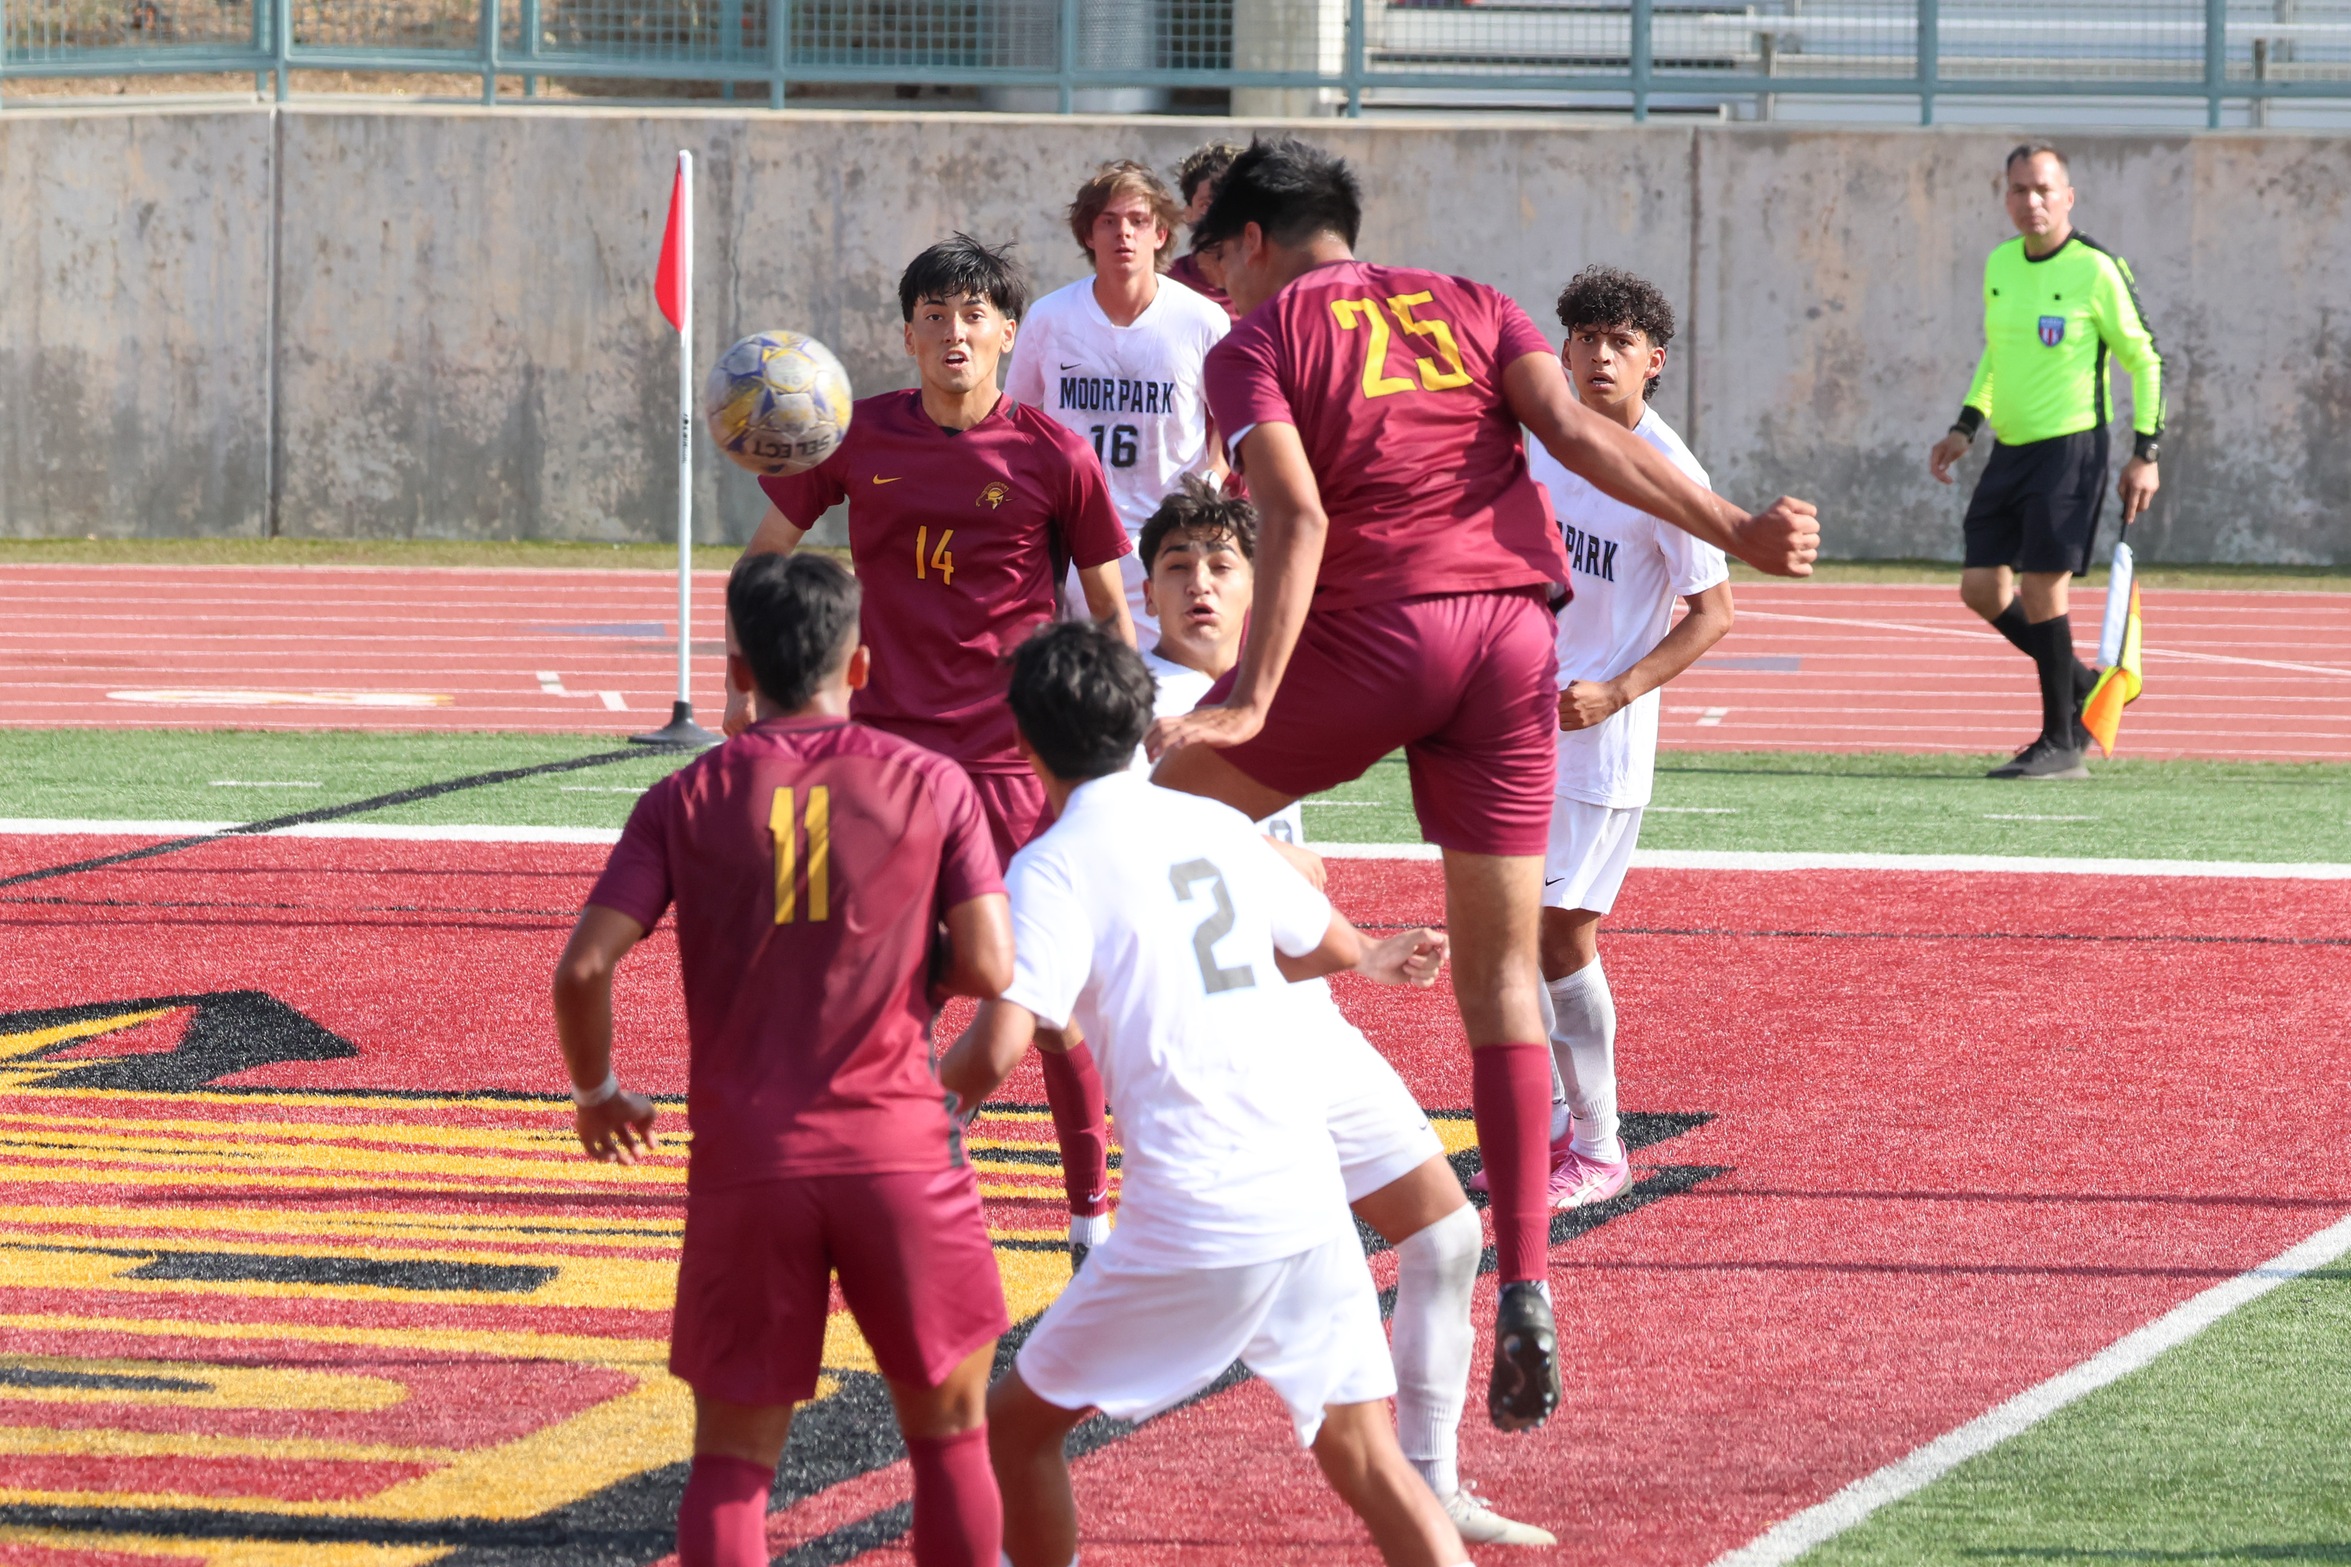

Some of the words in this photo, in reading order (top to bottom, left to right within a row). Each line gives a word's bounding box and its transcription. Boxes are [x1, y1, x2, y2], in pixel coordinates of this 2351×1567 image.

[1329, 288, 1475, 400] 25
[1059, 377, 1175, 414] MOORPARK
[753, 434, 831, 458] SELECT
[1090, 424, 1138, 468] 16
[916, 525, 954, 585] 14
[1556, 520, 1618, 582] PARK
[769, 785, 829, 925] 11
[1169, 857, 1256, 995] 2
